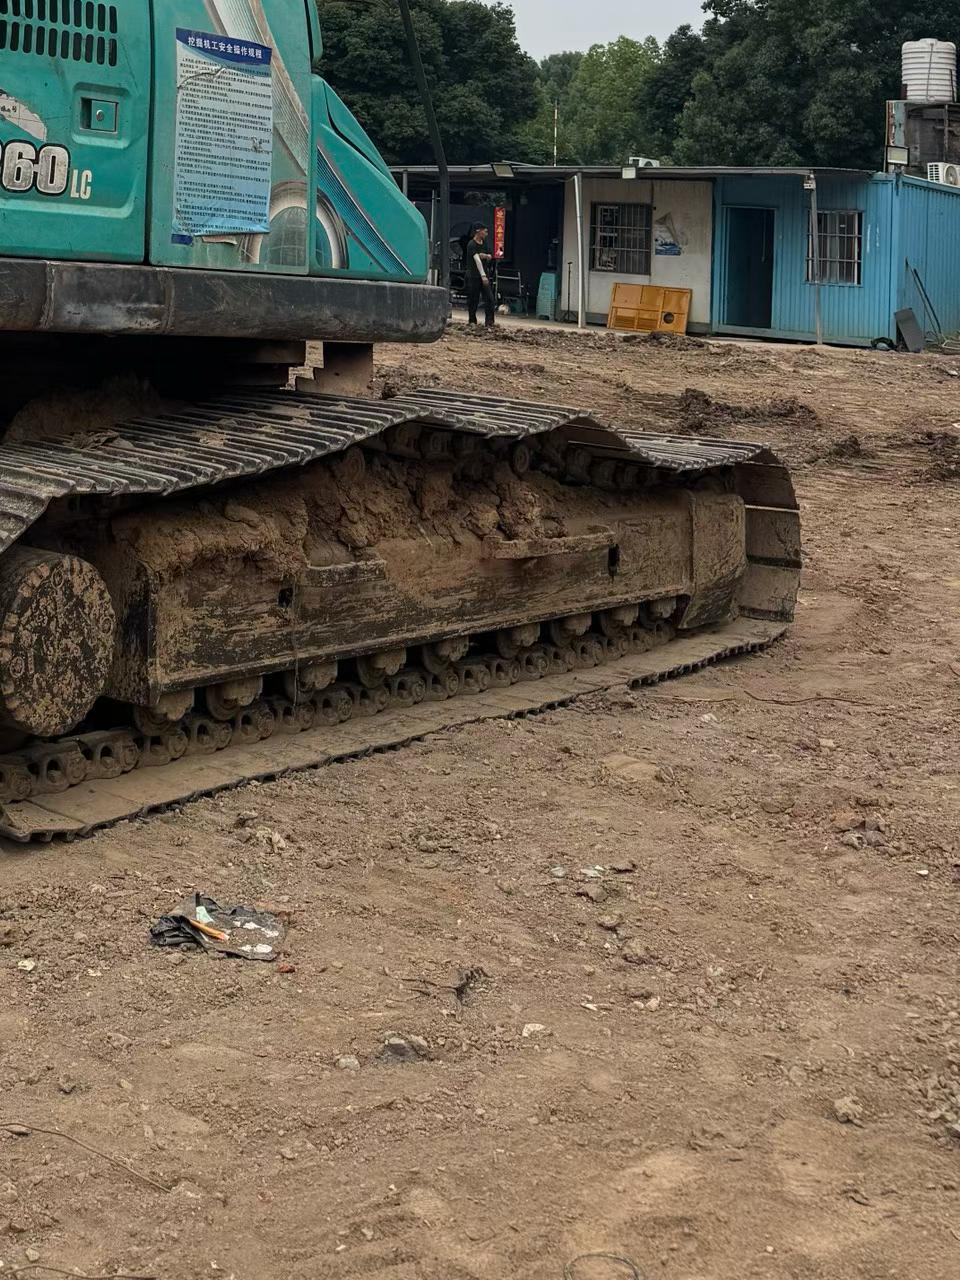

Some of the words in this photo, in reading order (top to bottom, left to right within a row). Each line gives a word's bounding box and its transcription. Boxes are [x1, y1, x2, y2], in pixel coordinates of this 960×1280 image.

[188, 36, 262, 59] 挖掘机工安全操作规程
[70, 169, 93, 200] LC
